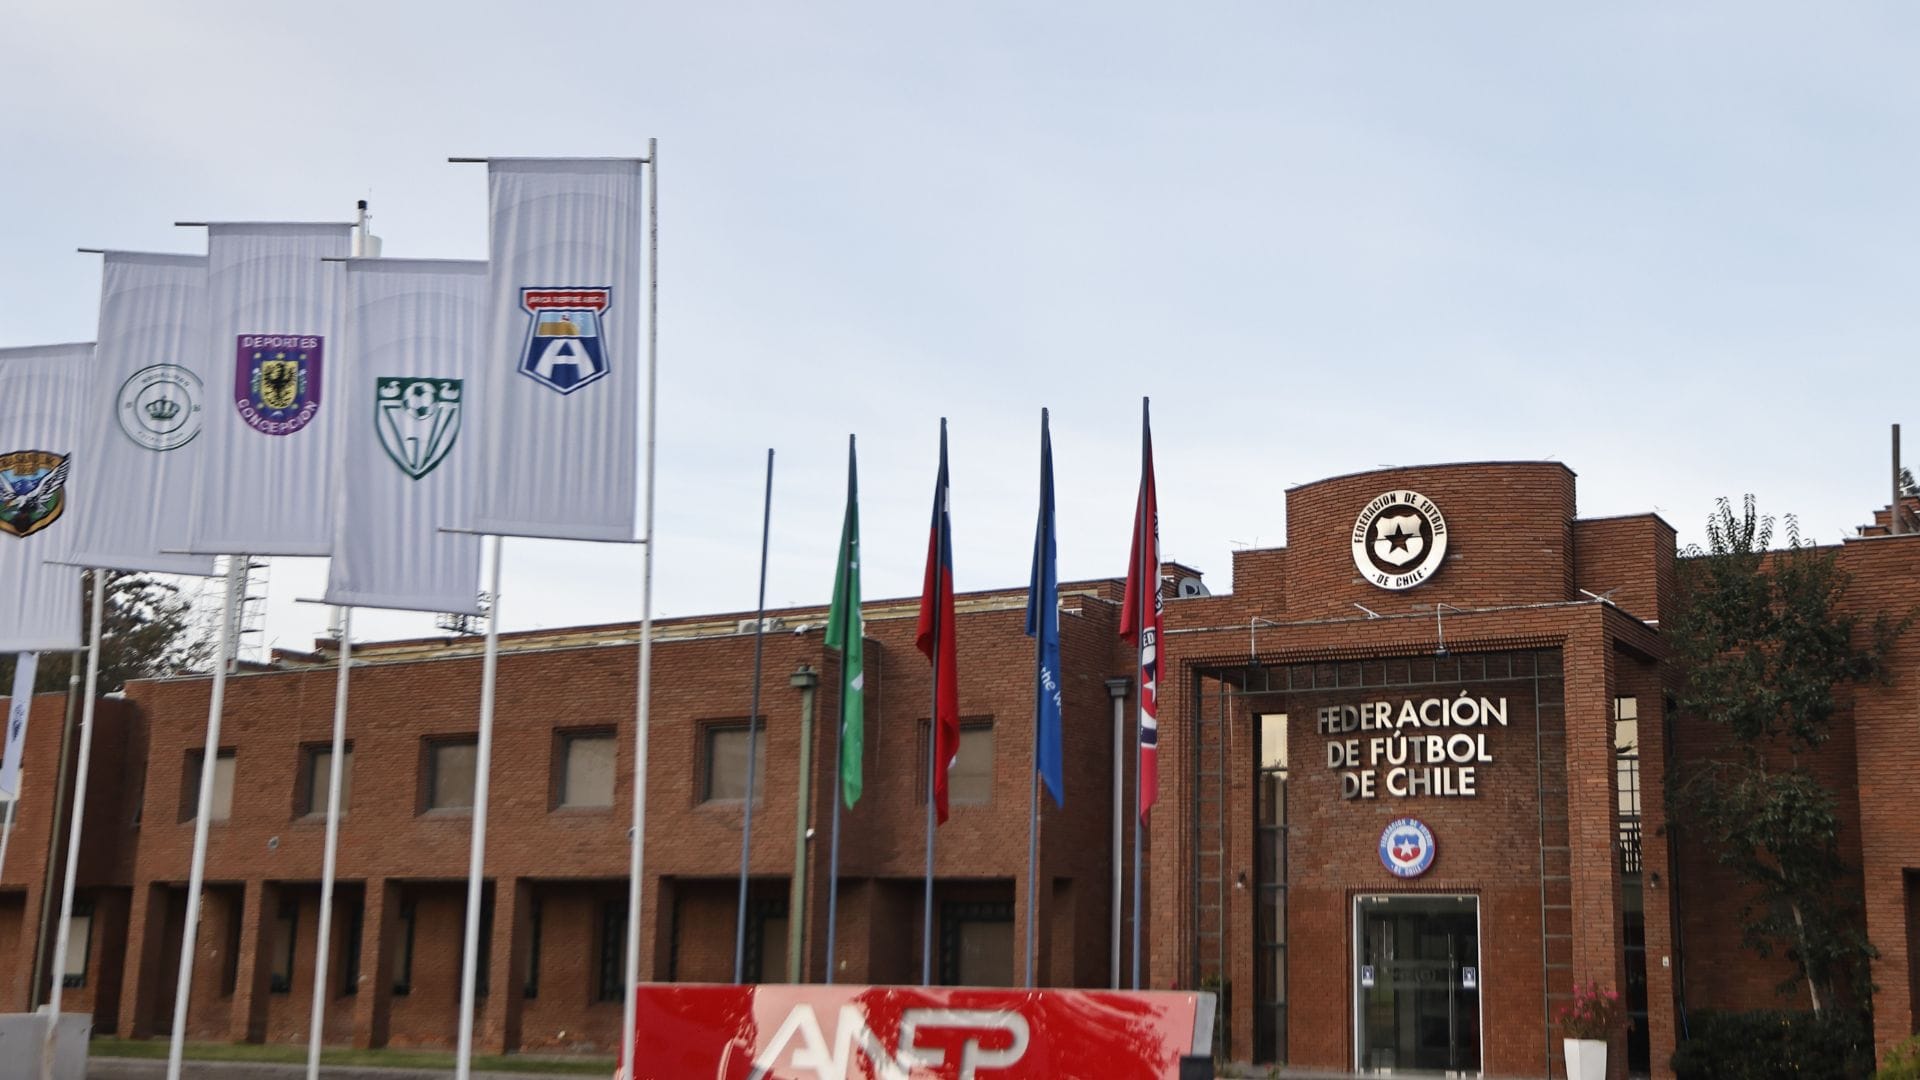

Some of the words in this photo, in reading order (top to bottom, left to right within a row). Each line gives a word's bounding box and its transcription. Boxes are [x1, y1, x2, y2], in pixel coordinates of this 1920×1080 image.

[242, 336, 318, 349] DEPORTES
[1354, 493, 1397, 544] FEDERACION
[1404, 492, 1418, 504] DE
[1420, 500, 1445, 537] FUTBOL
[1376, 574, 1390, 587] DE
[1396, 569, 1424, 588] CHILE
[1317, 689, 1508, 735] FEDERACIÓN
[1327, 738, 1360, 769] DE
[1370, 730, 1493, 766] FÚTBOL
[1341, 769, 1376, 800] DE
[1386, 766, 1476, 797] CHILE
